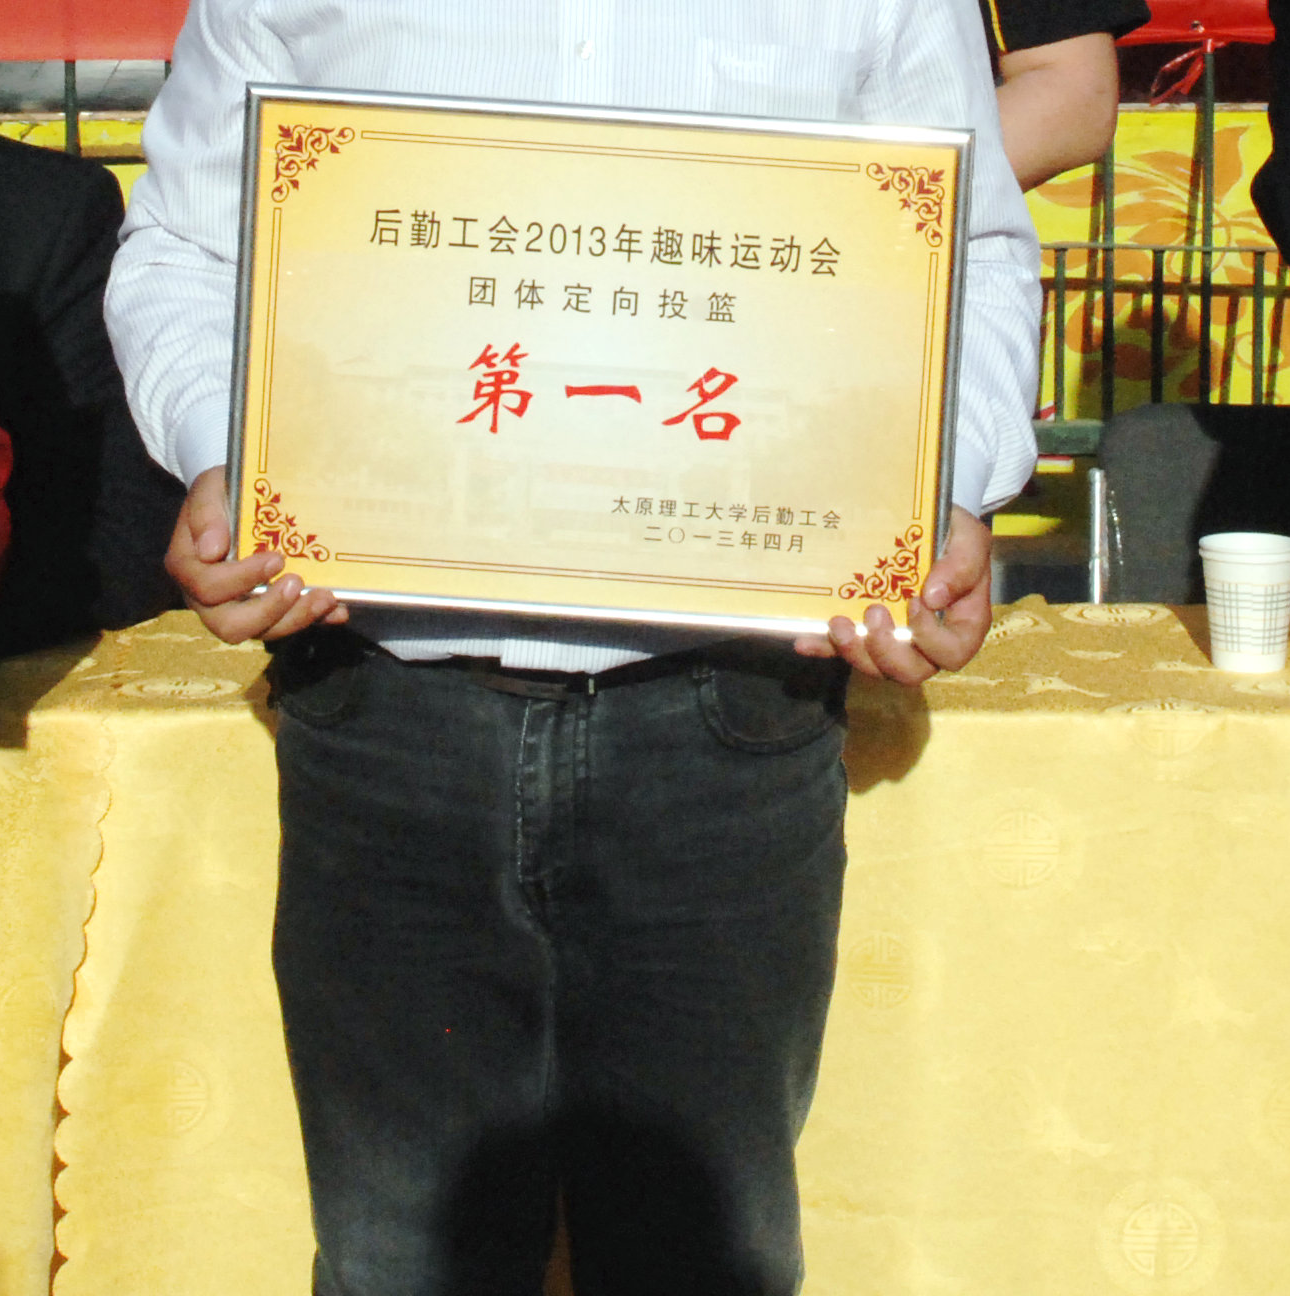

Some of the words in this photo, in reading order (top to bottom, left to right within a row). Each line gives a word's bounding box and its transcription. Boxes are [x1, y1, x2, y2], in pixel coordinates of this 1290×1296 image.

[369, 209, 841, 278] 后勤工会2013年趣味运动会
[468, 276, 738, 323] 团体定向投篮
[456, 342, 742, 442] 第一名
[611, 495, 842, 529] 太原理工大学后勤工会
